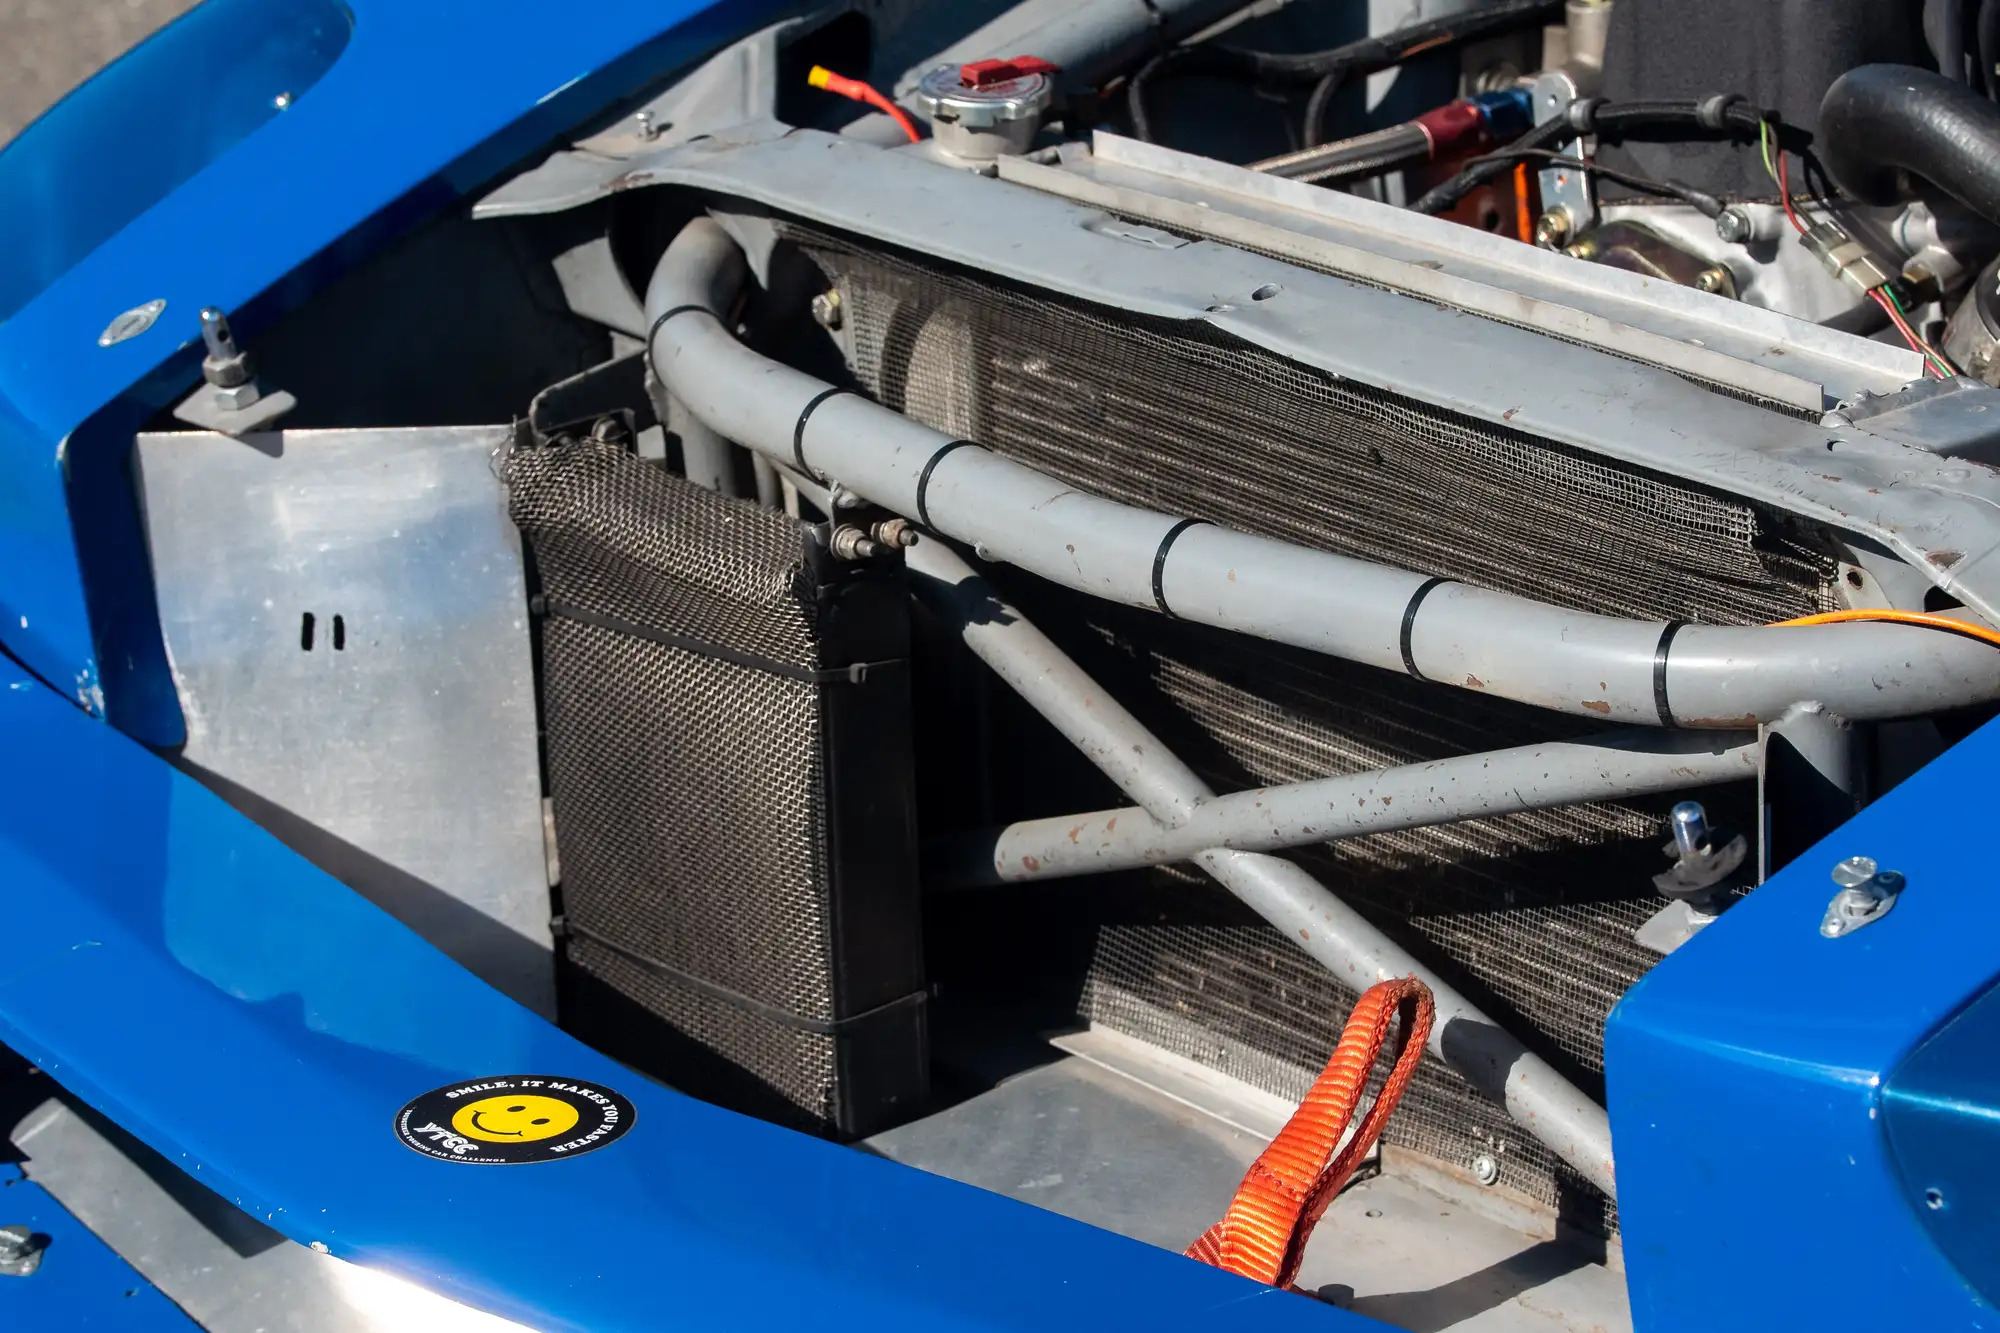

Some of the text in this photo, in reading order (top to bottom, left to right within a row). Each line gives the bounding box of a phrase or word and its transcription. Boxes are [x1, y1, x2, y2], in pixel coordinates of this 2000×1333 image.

[446, 1081, 515, 1099] SMILE,
[548, 1082, 610, 1104] MAKES
[602, 1104, 619, 1123] YOU
[406, 1135, 431, 1151] TOURING
[431, 1149, 447, 1157] CAR
[450, 1154, 506, 1162] CHALLENGE
[413, 1122, 479, 1154] YTCC
[549, 1124, 614, 1152] FASTER
